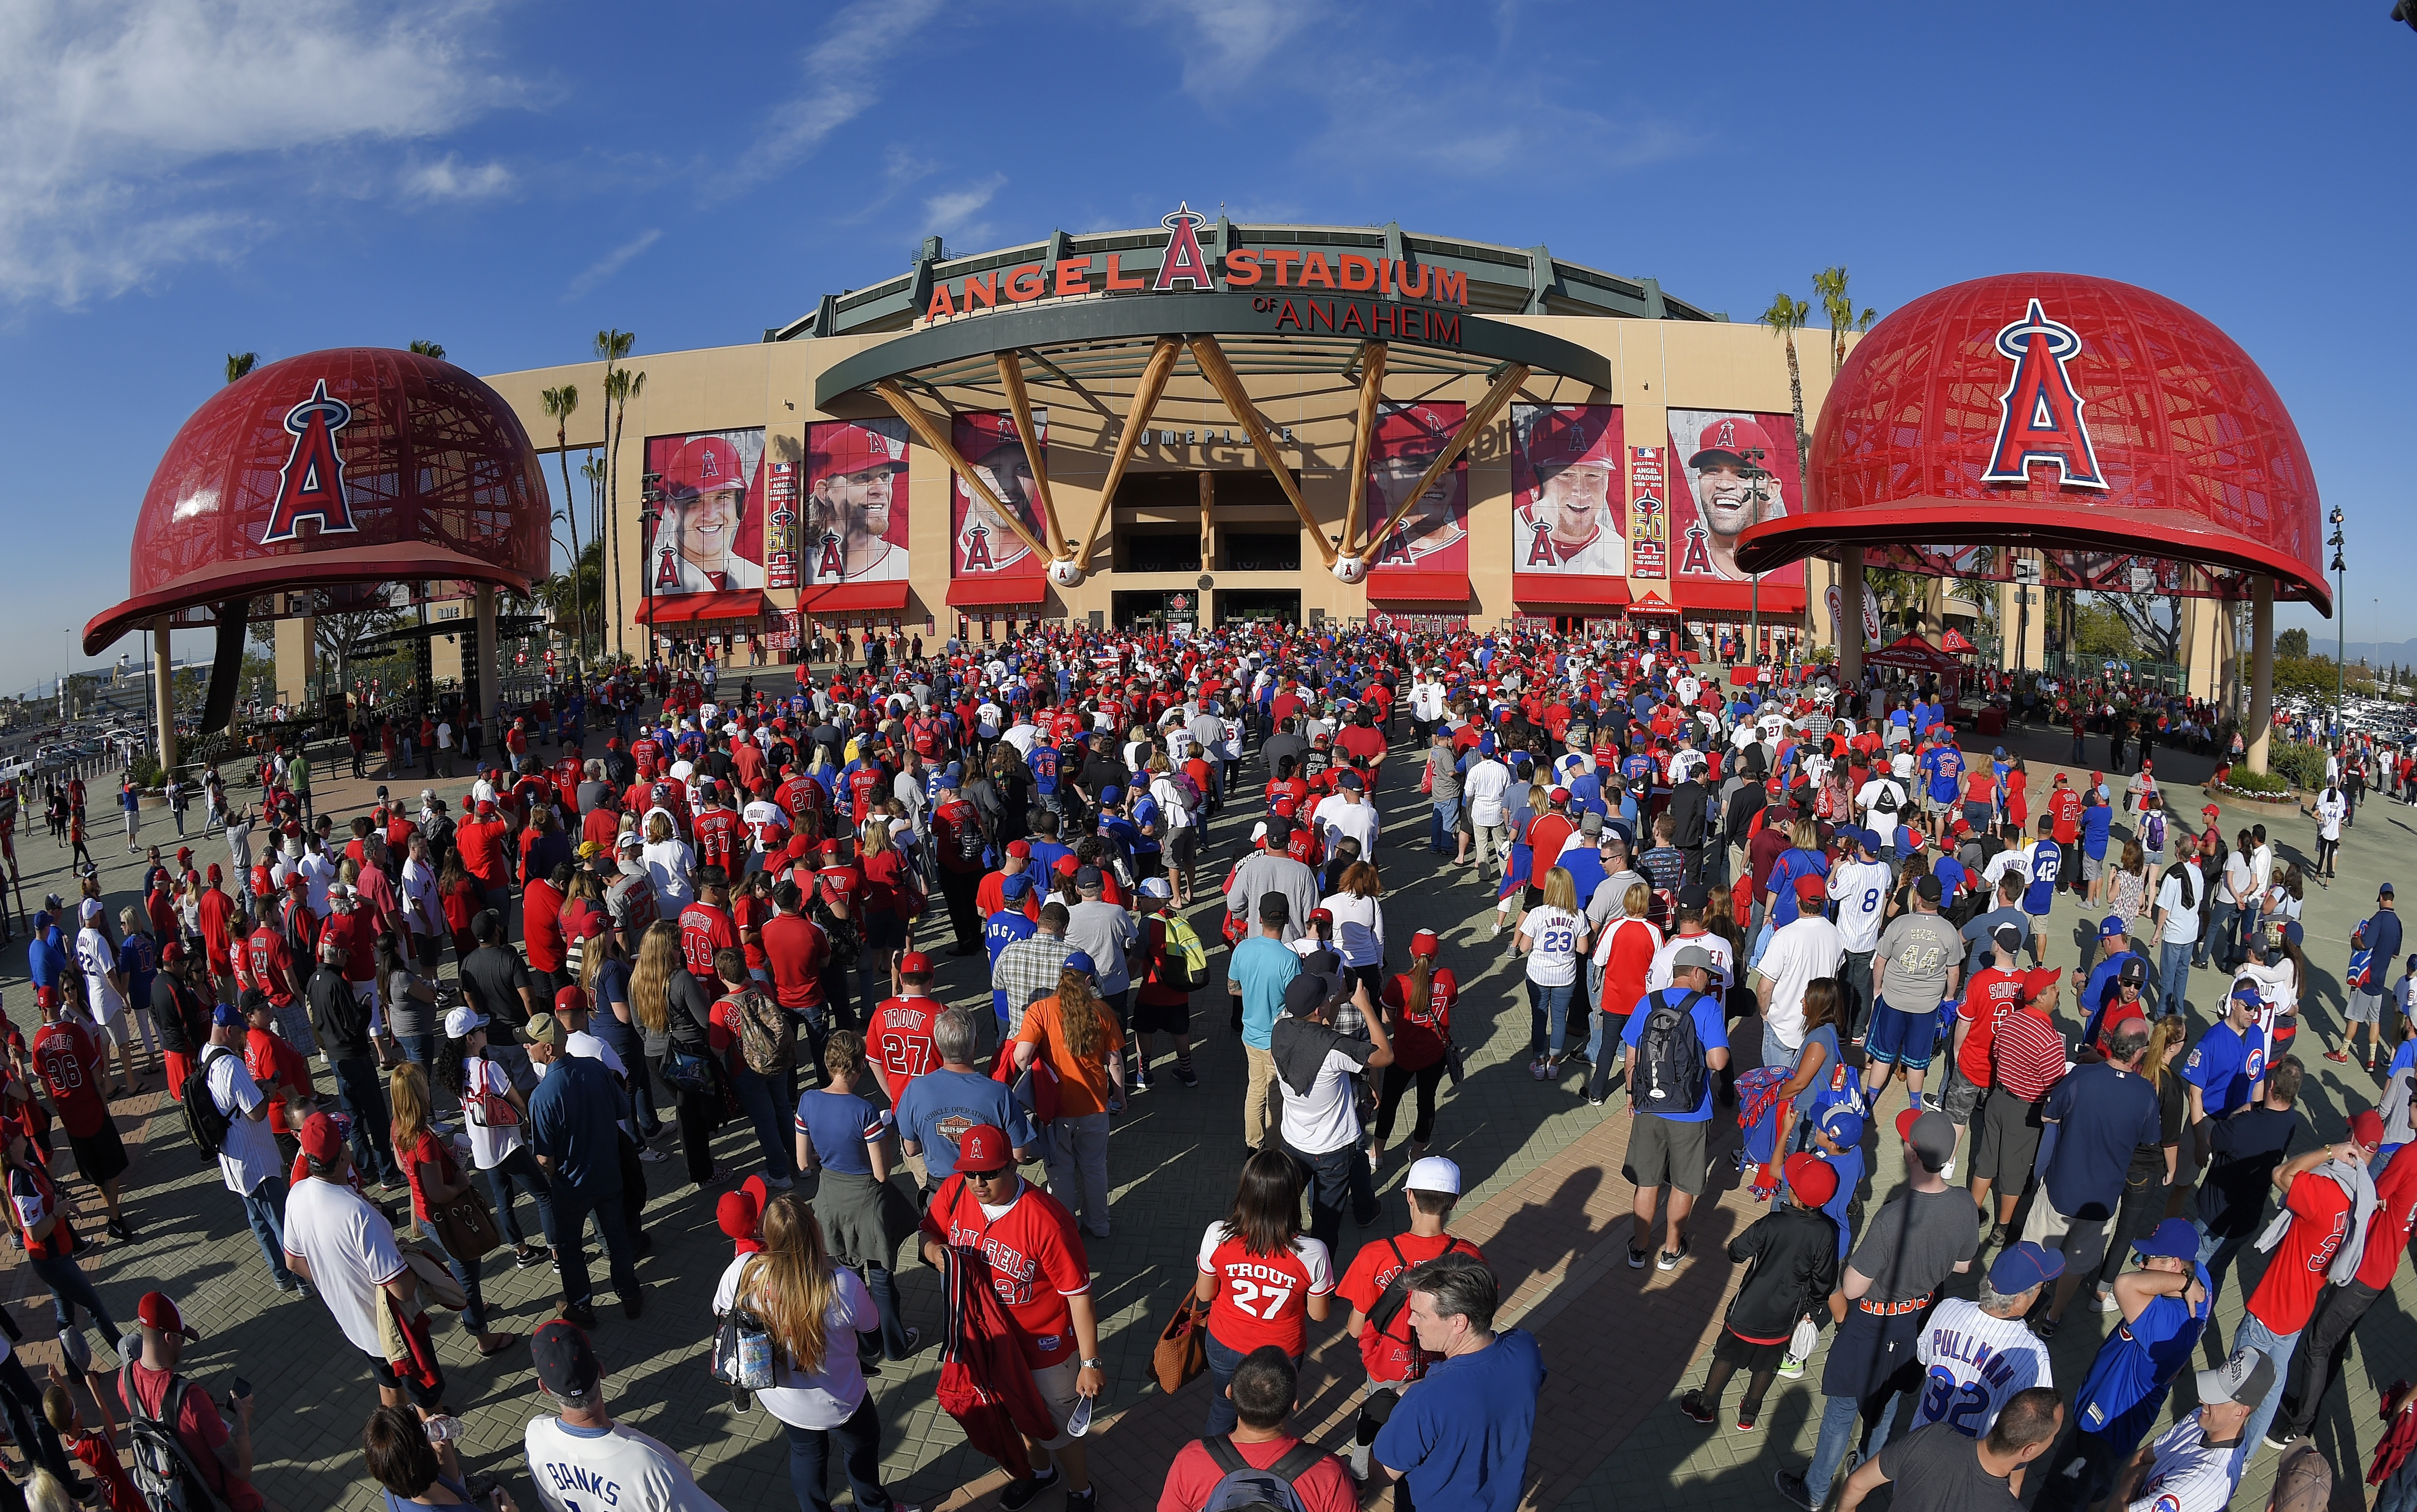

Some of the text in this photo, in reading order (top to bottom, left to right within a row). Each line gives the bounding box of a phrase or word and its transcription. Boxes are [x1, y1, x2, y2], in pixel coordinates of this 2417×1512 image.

[925, 201, 1468, 322] ANGEL A STADIUM
[1252, 297, 1461, 345] OF ANAHEIM
[1980, 298, 2110, 490] A
[260, 378, 360, 545] A
[1633, 513, 1664, 541] 50
[768, 525, 797, 553] 50
[518, 654, 524, 663] 2
[546, 650, 552, 659] 2
[1422, 693, 1428, 702] 5
[982, 711, 992, 720] 27
[1037, 720, 1053, 730] 27
[1177, 734, 1194, 742] BRYANT
[1227, 728, 1234, 740] 5
[1768, 726, 1780, 737] 27
[638, 752, 654, 766] 27
[1308, 753, 1327, 762] TROUT
[1680, 754, 1700, 763] BRYANT
[1037, 761, 1056, 776] 49
[1940, 762, 1956, 777] 38
[560, 772, 570, 787] 5
[789, 779, 810, 789] TROUT
[854, 776, 875, 786] PUJOLS
[1272, 783, 1292, 792] TROUT
[791, 789, 815, 813] 27
[860, 788, 870, 804] 5
[746, 809, 764, 820] TROUT
[950, 806, 974, 818] TROUT
[2062, 804, 2079, 821] 27
[2327, 810, 2337, 820] 44
[701, 817, 729, 831] TROUT
[704, 831, 730, 857] 27
[2002, 860, 2028, 871] ARRIETA
[2036, 861, 2057, 882] 42
[624, 881, 648, 901] TROUT
[1862, 888, 1879, 912] 8
[630, 894, 656, 929] 27
[682, 912, 713, 932] HUNTER
[1545, 917, 1574, 929] LAURIE
[1544, 931, 1573, 952] 23
[1911, 929, 1937, 942] RIZZO
[681, 932, 714, 966] 48
[78, 951, 97, 976] 22
[138, 947, 154, 973] 17
[252, 951, 268, 974] 27
[1899, 944, 1939, 975] 44
[882, 1009, 926, 1031] TROUT
[41, 1033, 73, 1057] WEAVER
[881, 1033, 931, 1076] 27
[45, 1054, 82, 1090] 36
[924, 1106, 993, 1124] VEHICLE OPERATIONS
[949, 1219, 1035, 1281] ANGELS
[1225, 1263, 1297, 1288] TROUT
[994, 1278, 1032, 1305] 27
[1232, 1279, 1290, 1319] 27
[1933, 1329, 2015, 1390] PULLMAN
[1922, 1365, 1989, 1436] 32
[546, 1462, 622, 1507] BANKS
